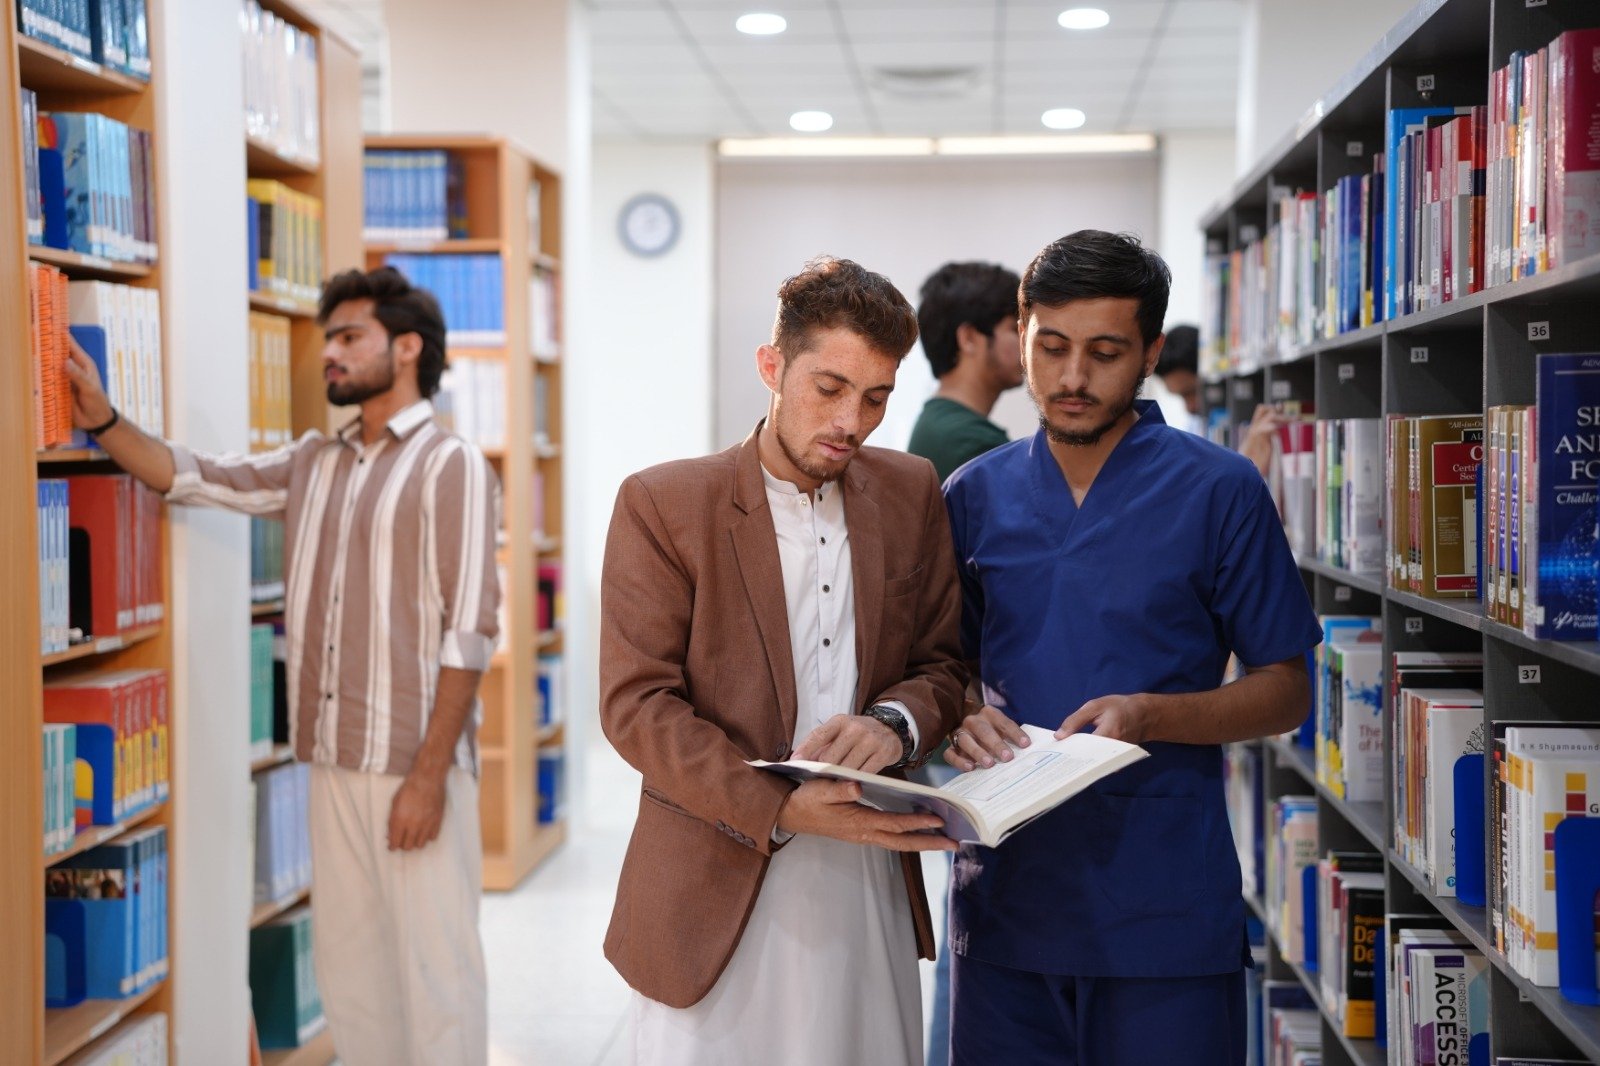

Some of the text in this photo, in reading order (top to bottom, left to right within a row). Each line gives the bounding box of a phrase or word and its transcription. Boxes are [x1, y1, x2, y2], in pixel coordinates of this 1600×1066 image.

[1420, 79, 1433, 88] 30
[1531, 325, 1547, 337] 36
[1413, 350, 1426, 360] 31
[1408, 620, 1420, 630] 32
[1521, 669, 1537, 680] 37
[1589, 803, 1599, 814] G
[1458, 972, 1468, 1023] MICROSOFT
[1434, 972, 1458, 1066] ACCESS
[1459, 1027, 1469, 1059] OFFICE
